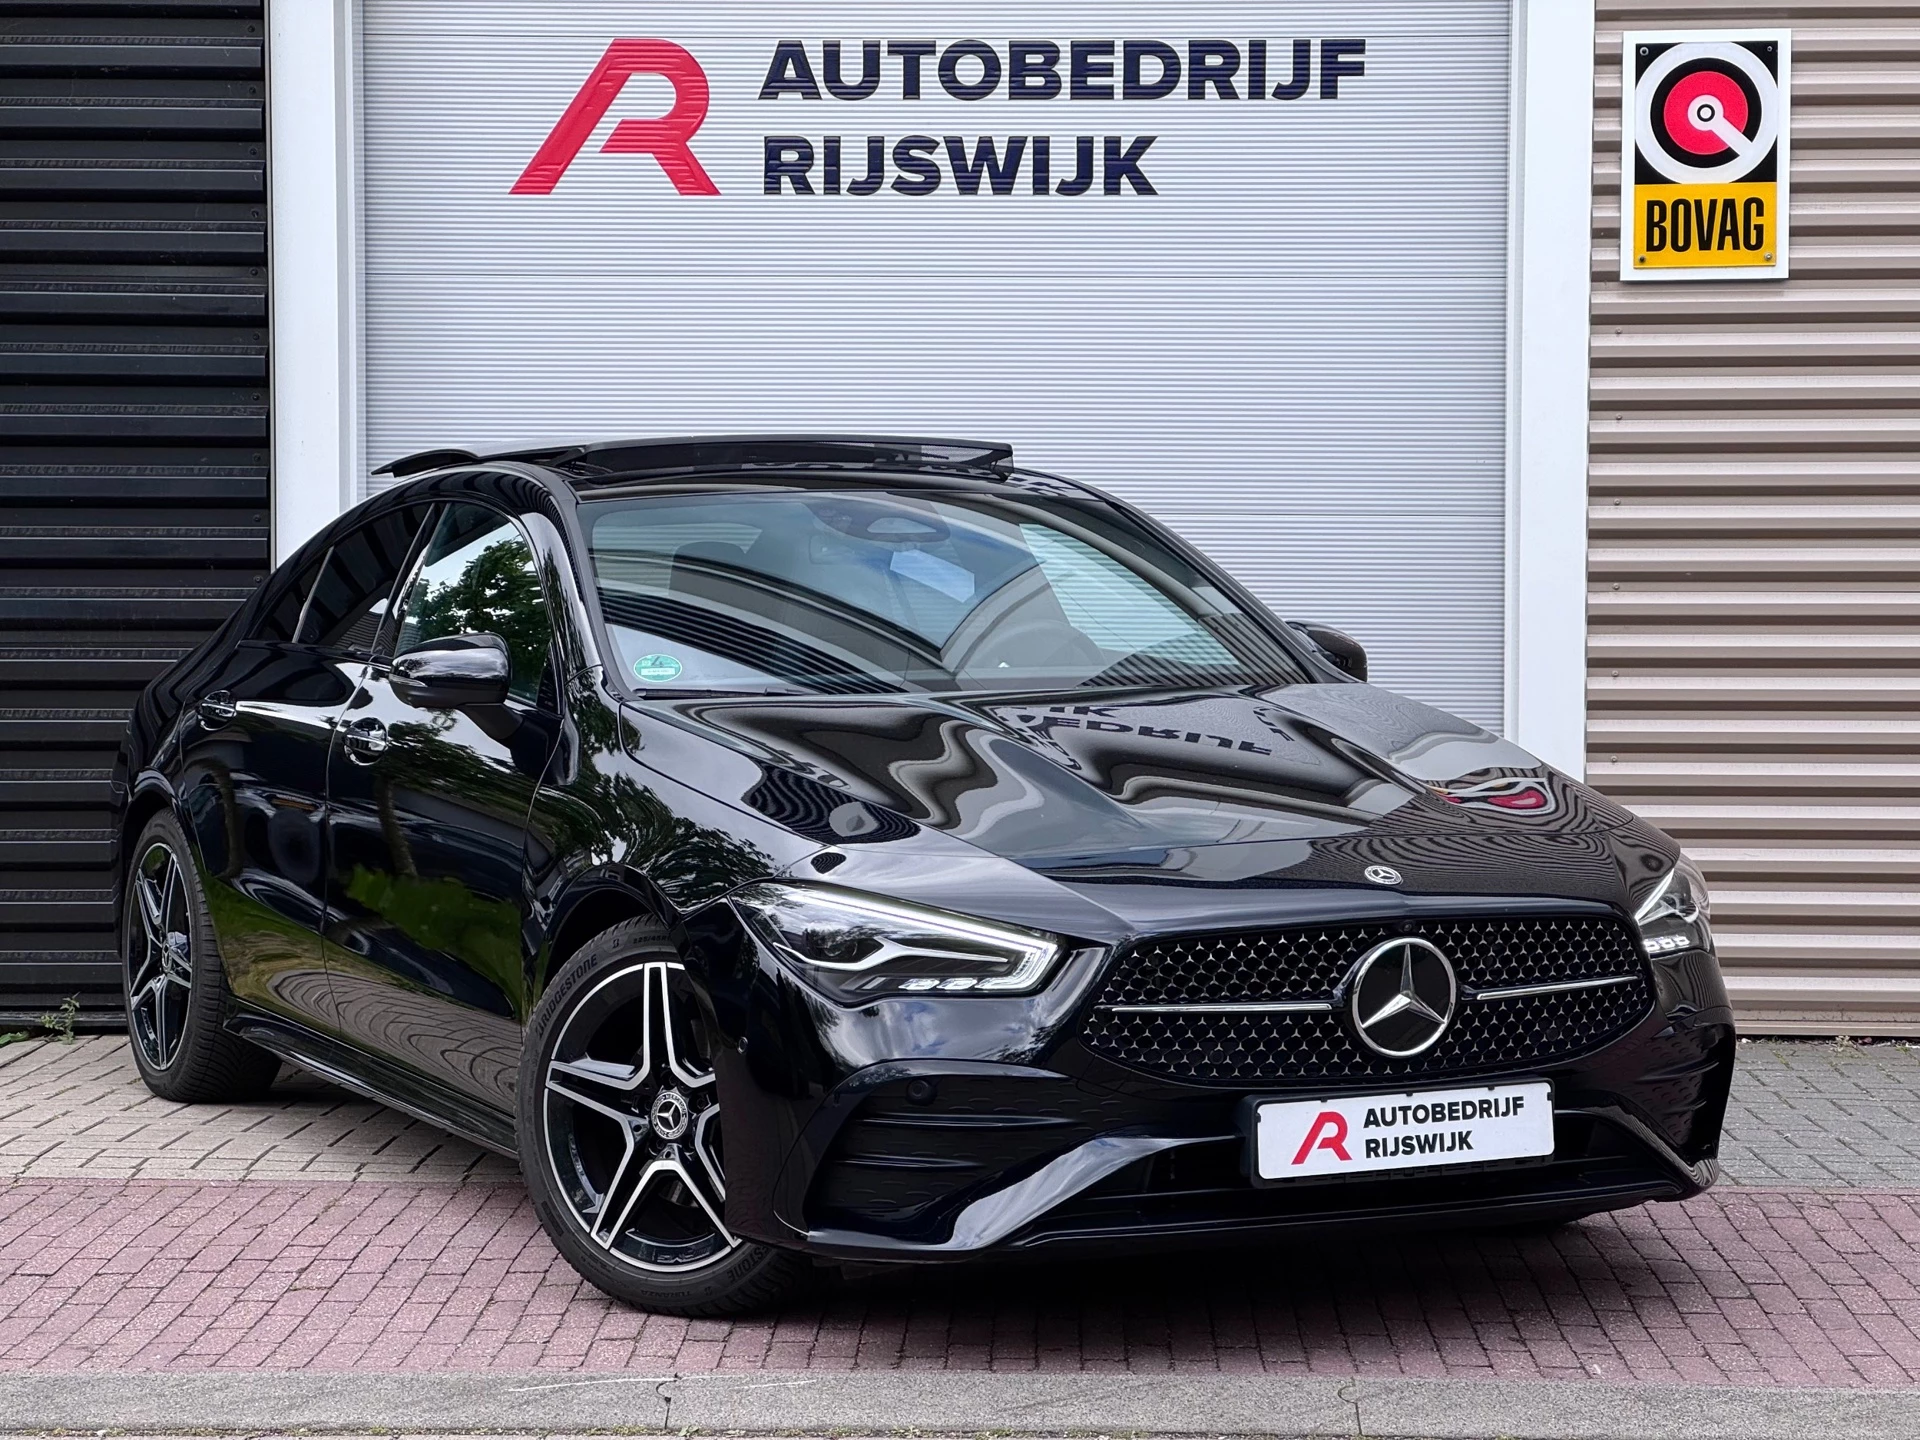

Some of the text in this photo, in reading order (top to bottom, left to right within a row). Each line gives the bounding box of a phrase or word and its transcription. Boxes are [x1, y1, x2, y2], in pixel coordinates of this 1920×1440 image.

[758, 39, 1366, 100] AUTOBEDRIJF
[762, 135, 1158, 195] RIJSWIJK
[1646, 197, 1764, 252] BOVAG
[632, 934, 670, 945] 225/45R1
[535, 953, 598, 1040] BRIDGESTONE
[1363, 1096, 1525, 1128] AUTOBEDRIJF
[1365, 1130, 1474, 1159] RIJSWIJK
